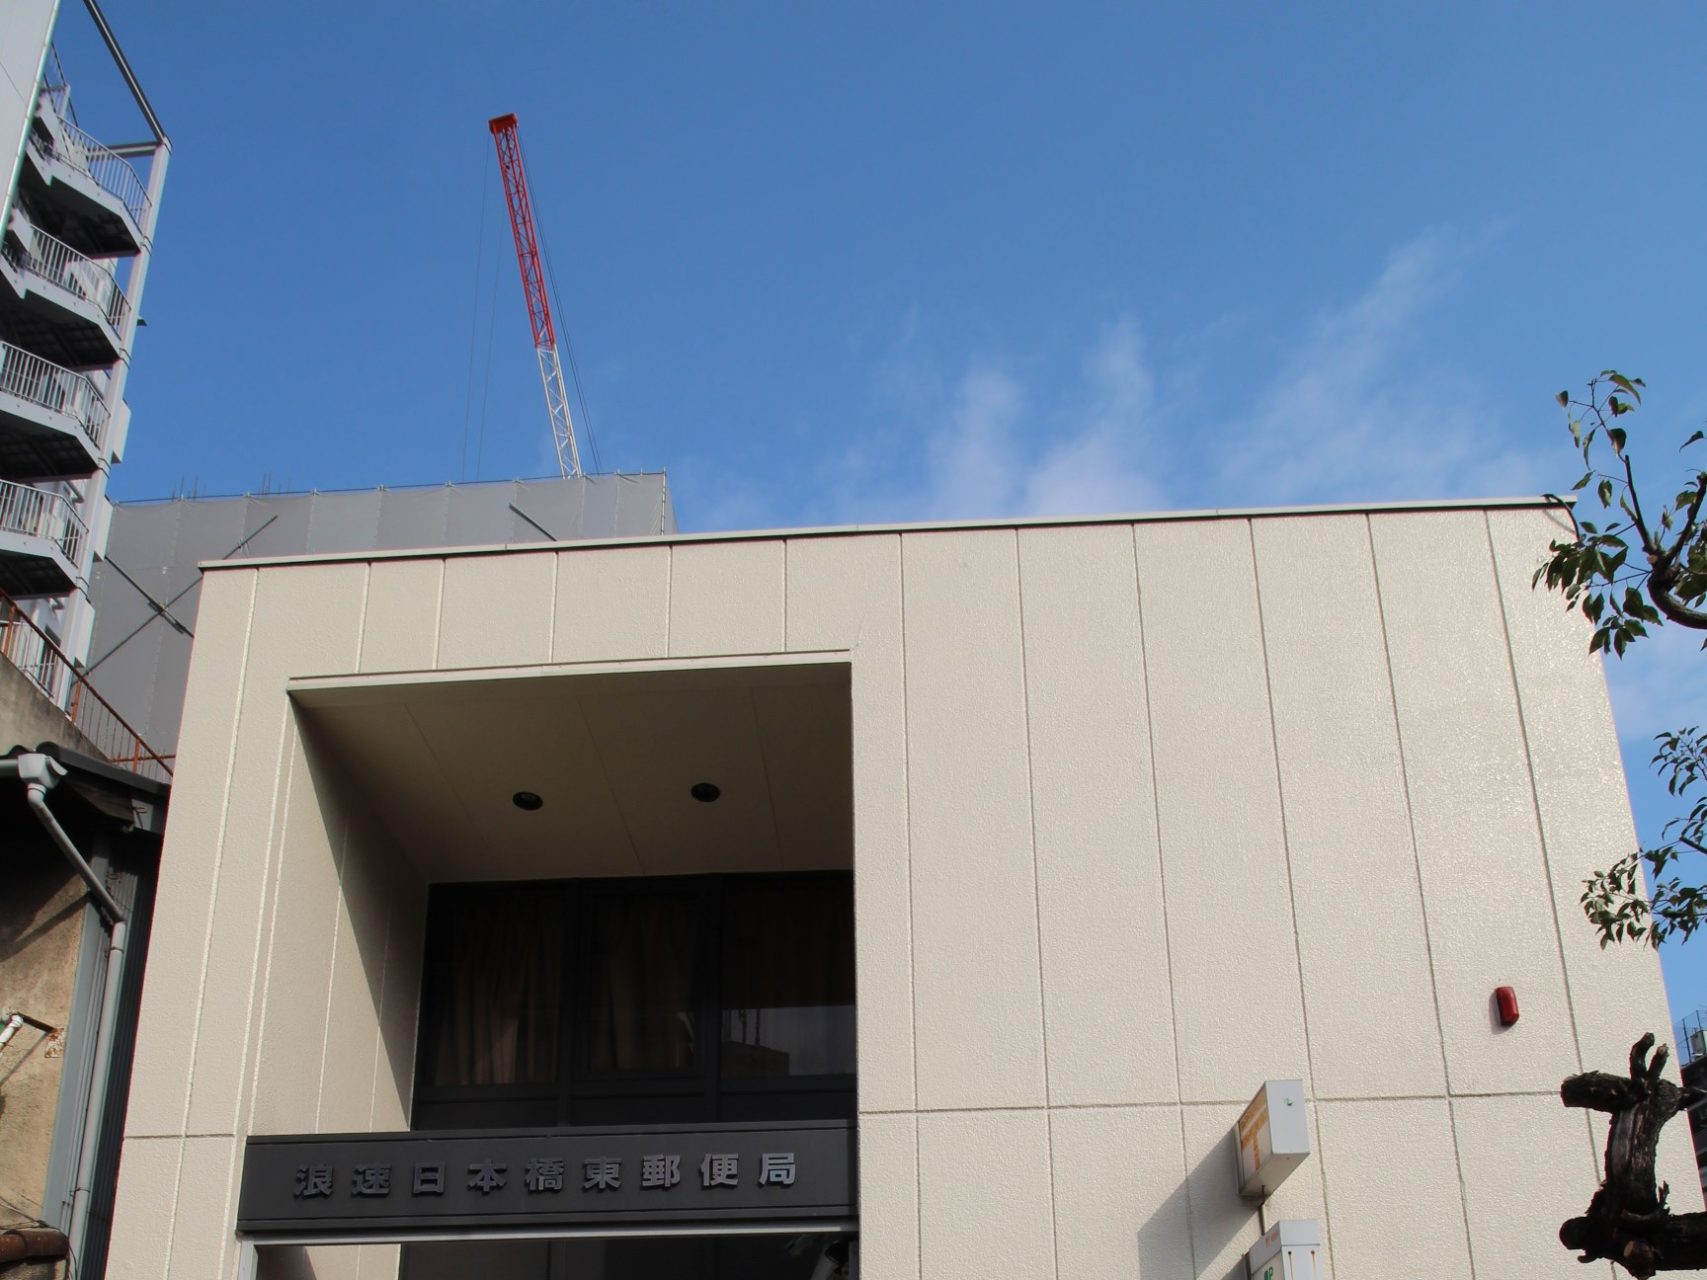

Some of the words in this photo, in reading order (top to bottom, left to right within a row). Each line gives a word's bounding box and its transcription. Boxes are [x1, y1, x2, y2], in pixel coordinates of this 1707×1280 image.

[293, 1152, 797, 1198] 浪速日本橋東郵便局
